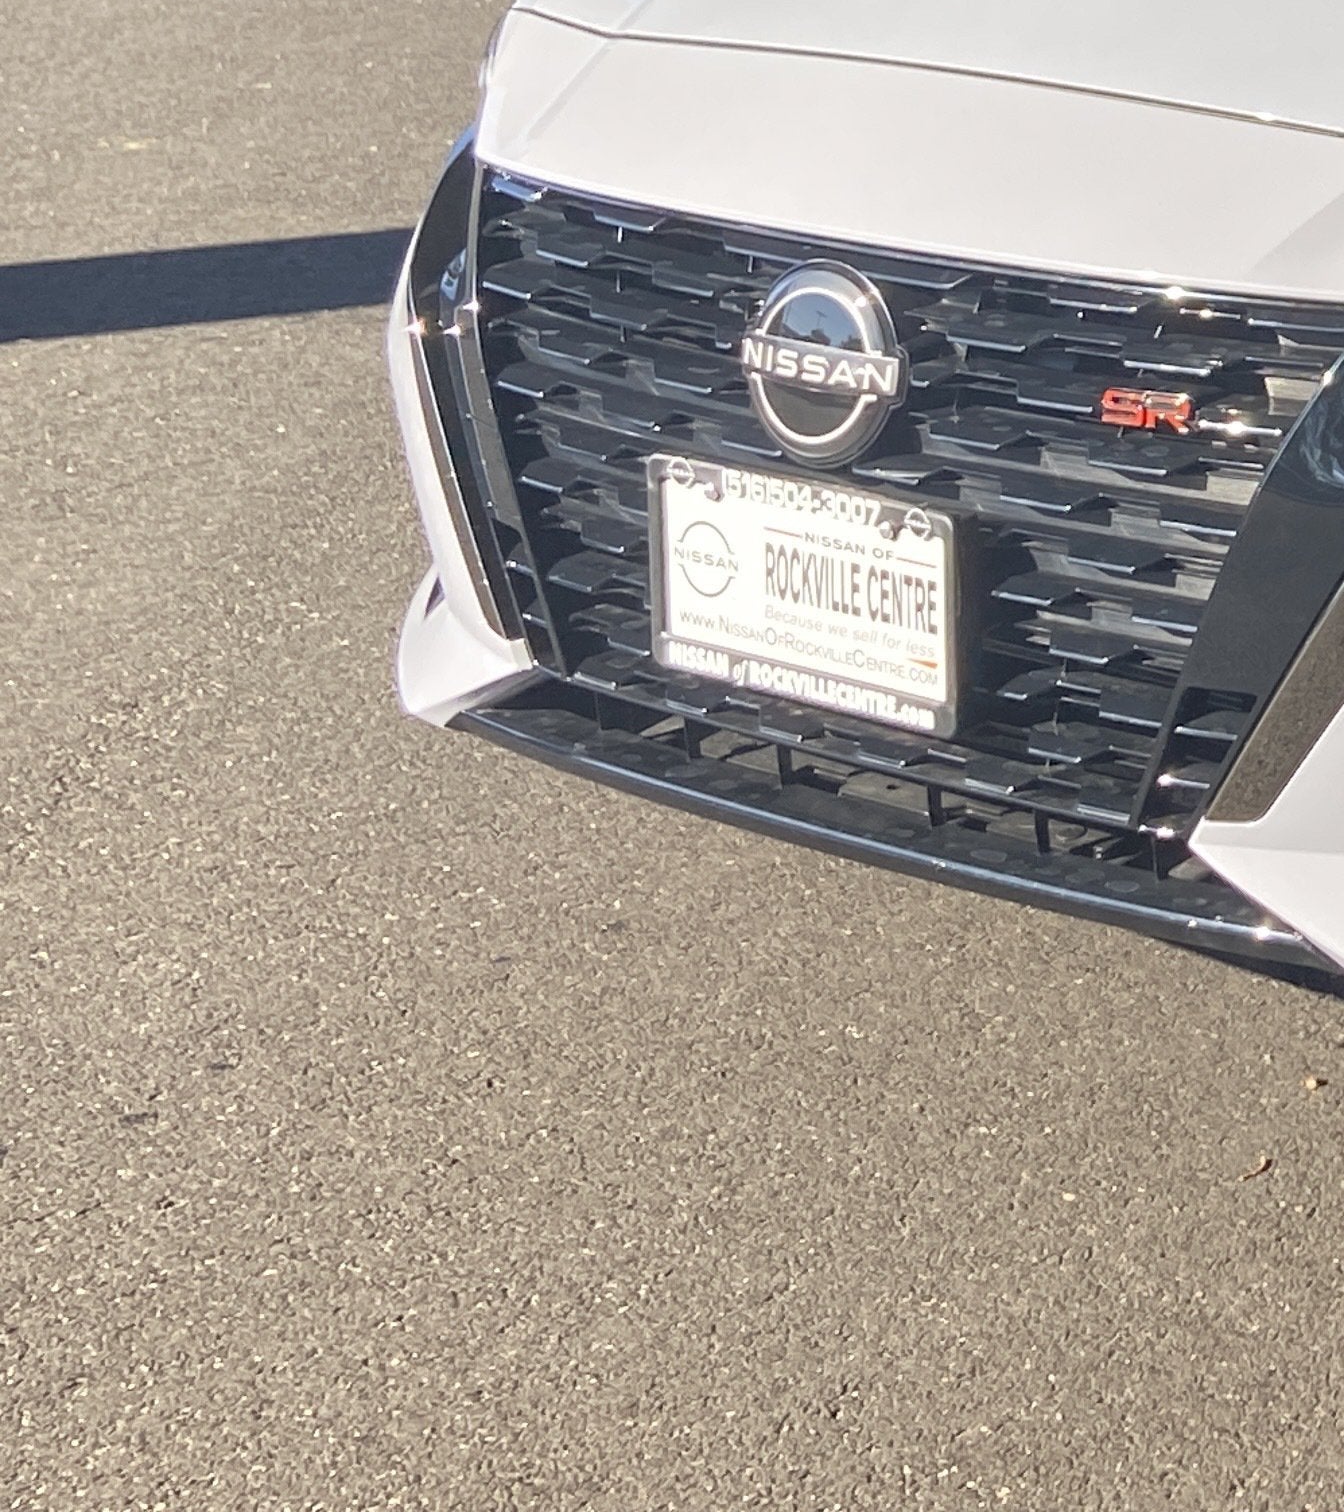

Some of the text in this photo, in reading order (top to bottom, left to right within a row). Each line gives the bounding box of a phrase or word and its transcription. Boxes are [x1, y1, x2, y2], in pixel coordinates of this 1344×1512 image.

[742, 337, 893, 392] NISSAN
[1101, 387, 1191, 434] SR
[674, 546, 739, 572] NISSAN
[804, 532, 895, 561] NISSAN OF
[765, 541, 938, 635] ROCKVILLE CENTRE
[764, 604, 936, 658] Because we sell for less
[667, 639, 729, 679] NISSAN
